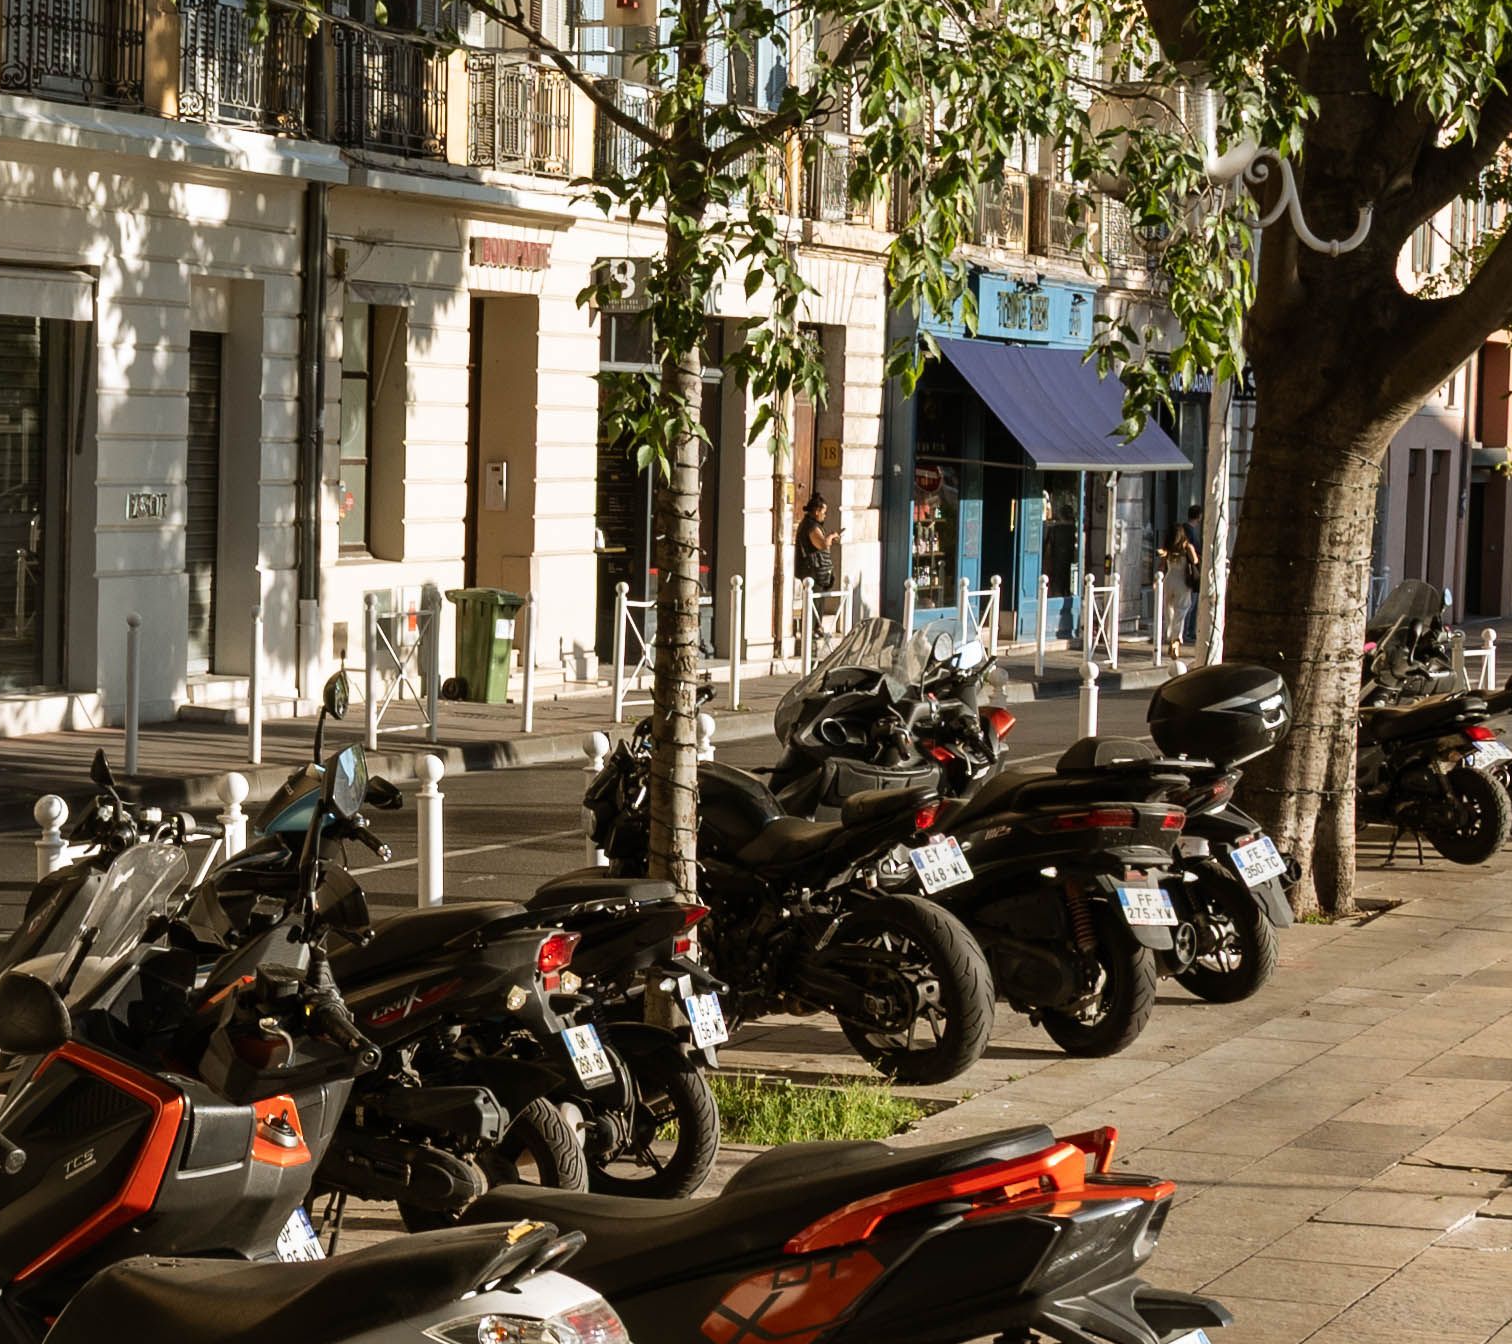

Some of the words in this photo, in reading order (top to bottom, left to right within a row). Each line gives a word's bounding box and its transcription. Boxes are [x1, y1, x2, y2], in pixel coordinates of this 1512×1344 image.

[824, 447, 837, 461] 18
[924, 860, 968, 886] 848-WL
[1244, 856, 1280, 879] 350-TC
